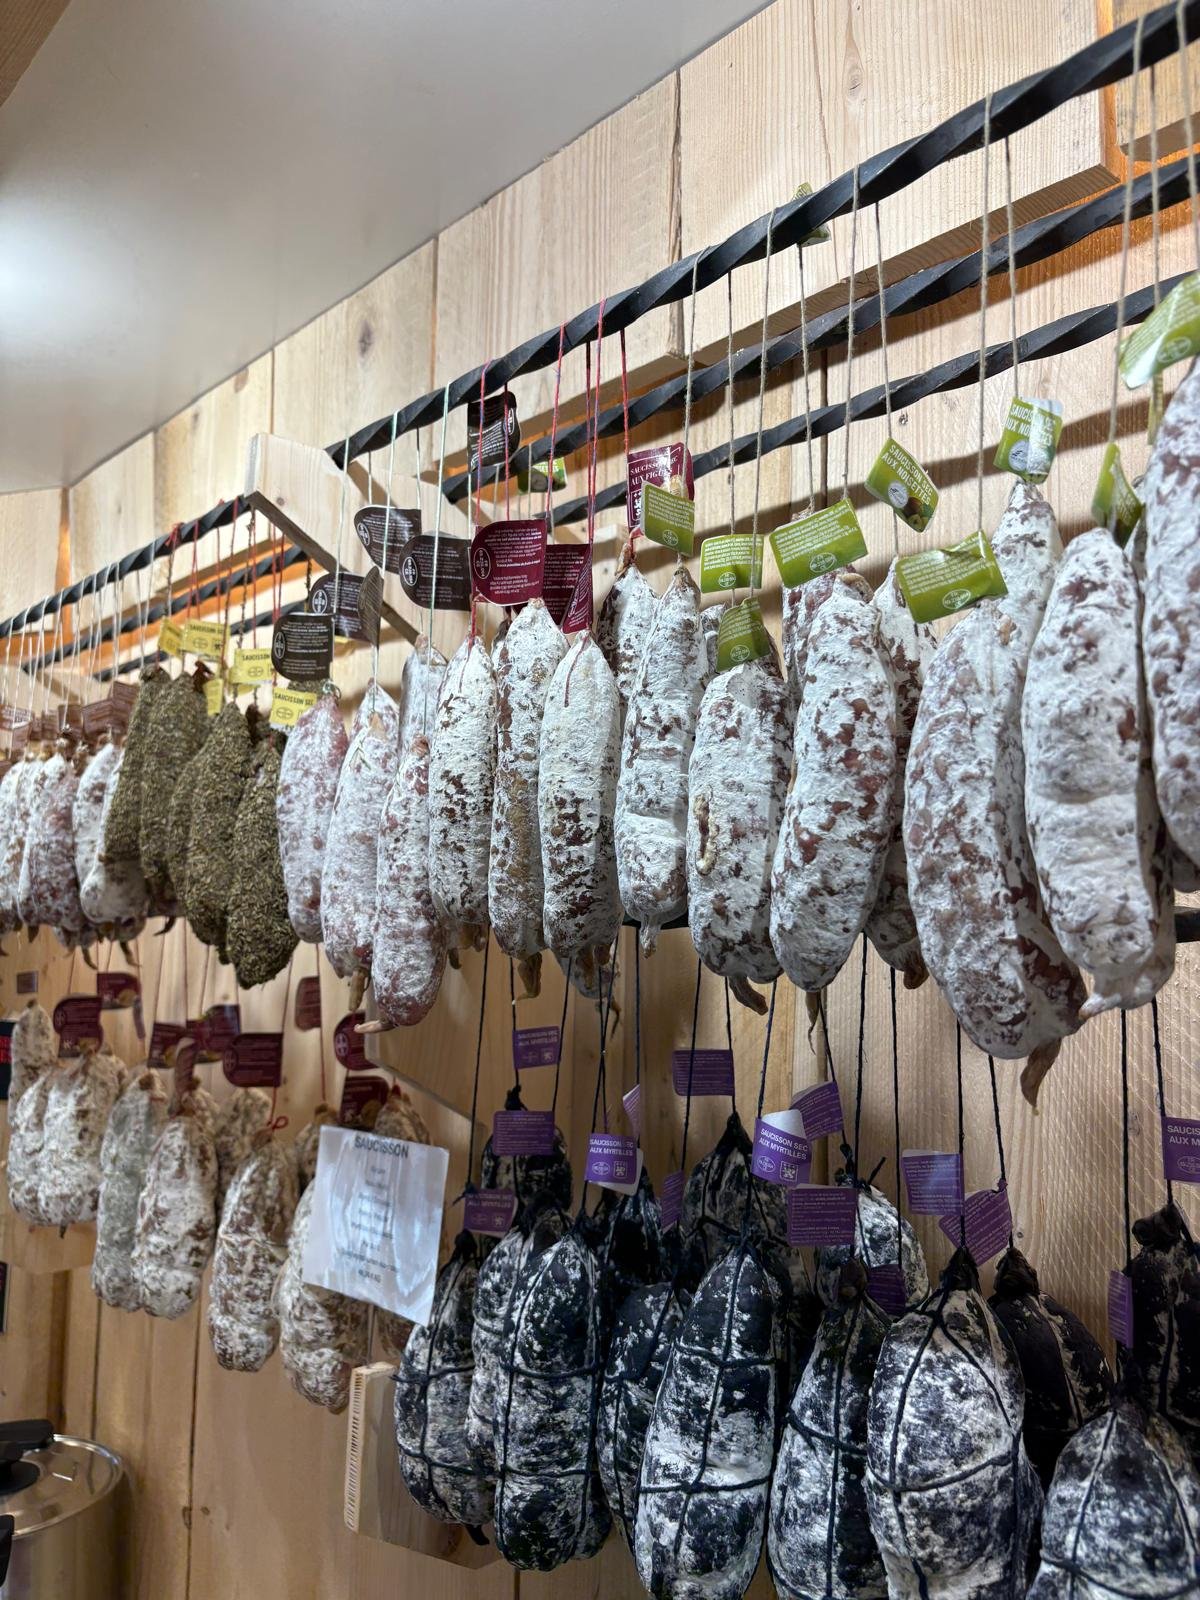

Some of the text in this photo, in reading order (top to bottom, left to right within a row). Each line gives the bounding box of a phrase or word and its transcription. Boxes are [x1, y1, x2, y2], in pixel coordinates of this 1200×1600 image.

[881, 453, 898, 469] AUX
[896, 465, 931, 506] NOISETTES
[889, 444, 924, 483] SAUCISSON
[921, 478, 933, 496] SEC
[354, 1136, 409, 1158] SAUCISSON
[759, 1137, 807, 1161] AUX MYRTILLES
[760, 1127, 809, 1152] SAUCISSON SEC
[1169, 1135, 1190, 1145] AUX
